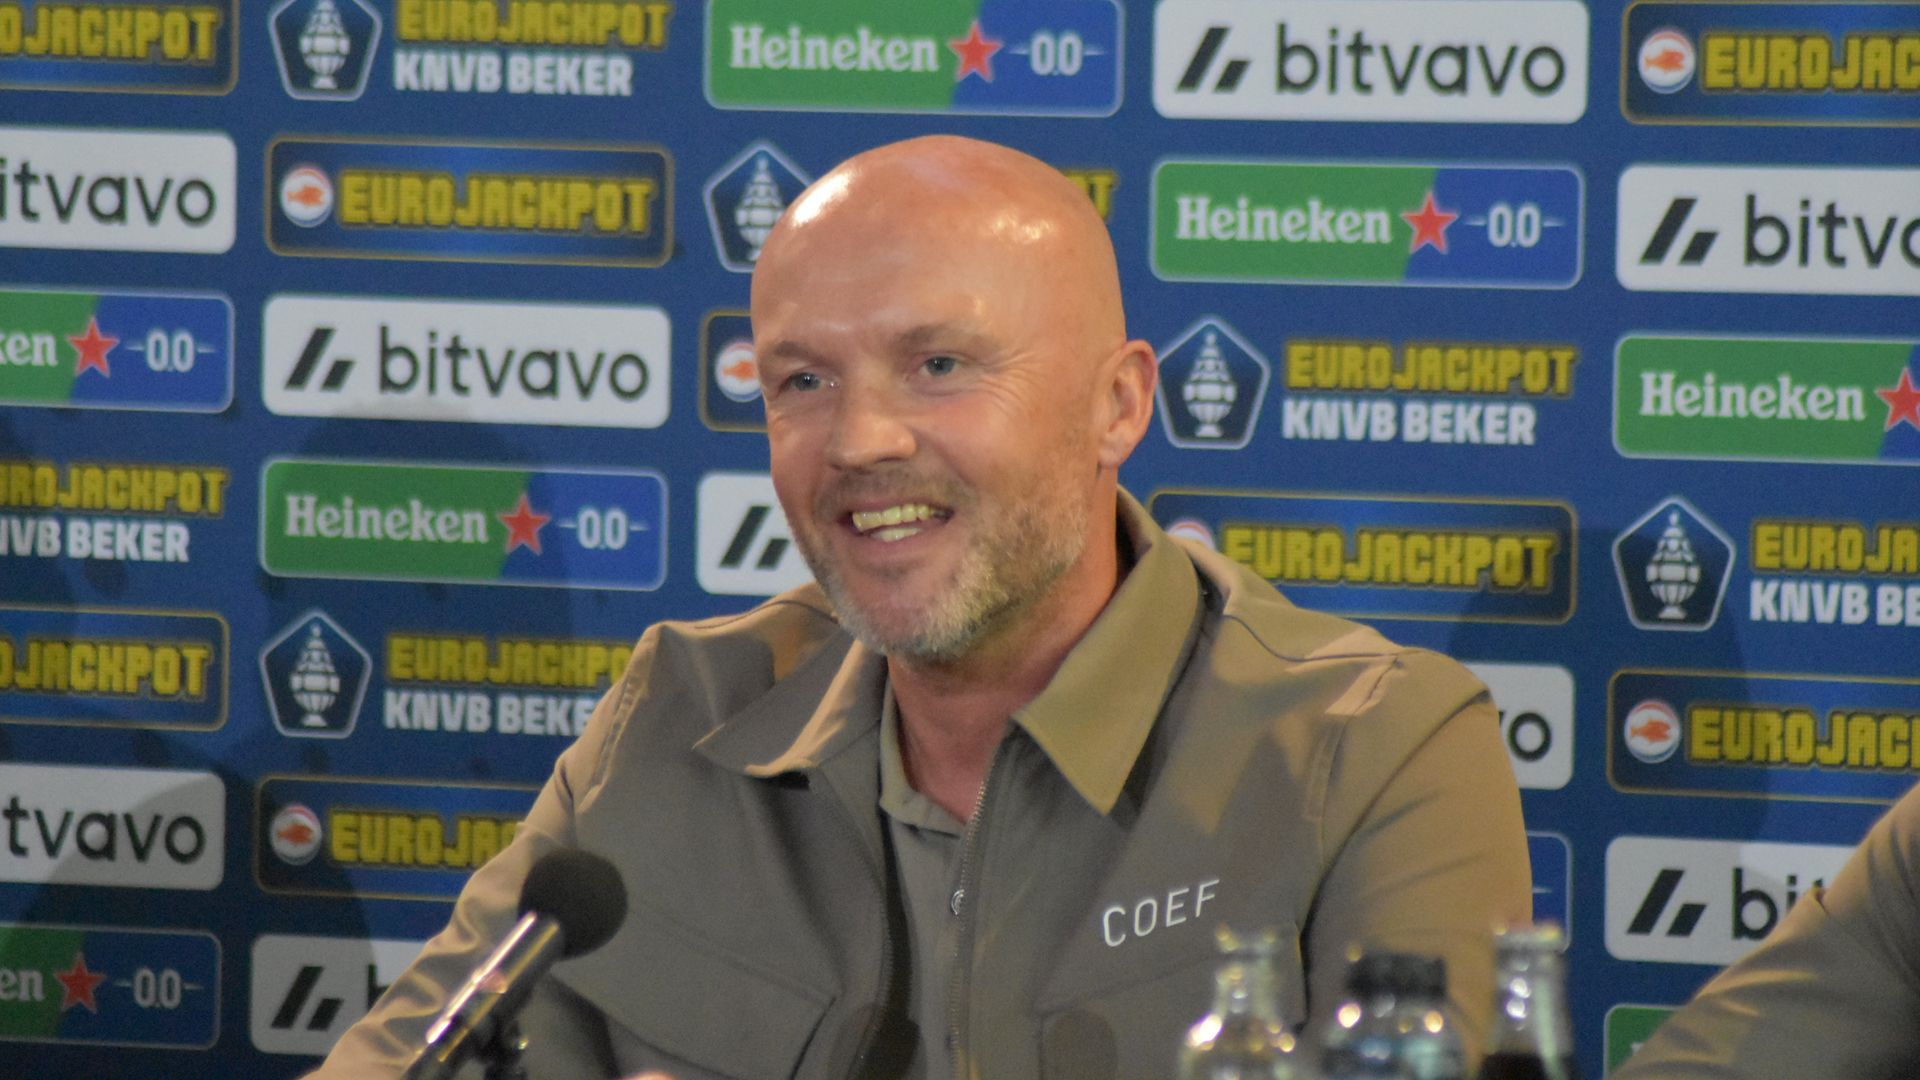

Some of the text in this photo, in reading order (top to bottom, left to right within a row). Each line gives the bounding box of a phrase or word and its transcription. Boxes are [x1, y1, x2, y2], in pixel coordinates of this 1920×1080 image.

[397, 0, 671, 46] EUROJACKPOT
[730, 24, 939, 72] Heineken
[394, 51, 633, 96] KNVB BEKER
[1276, 23, 1566, 96] bitvavo
[1703, 34, 1920, 90] EUROJAC
[339, 171, 653, 232] EUROJACKPOT
[1177, 195, 1391, 244] Heineken
[378, 325, 650, 398] bitvavo
[1286, 342, 1576, 394] EUROJACKPOT
[1640, 371, 1866, 421] Heineken
[1283, 399, 1536, 445] KNVB BEKER
[67, 519, 190, 562] BEKER
[285, 494, 489, 543] Heineken
[1224, 527, 1554, 588] EUROJACKPOT
[1753, 522, 1920, 574] EUROJA
[1750, 580, 1869, 624] KNVB
[384, 690, 491, 732] KNVB
[2, 796, 207, 866] tvavo
[1102, 879, 1220, 948] COEF
